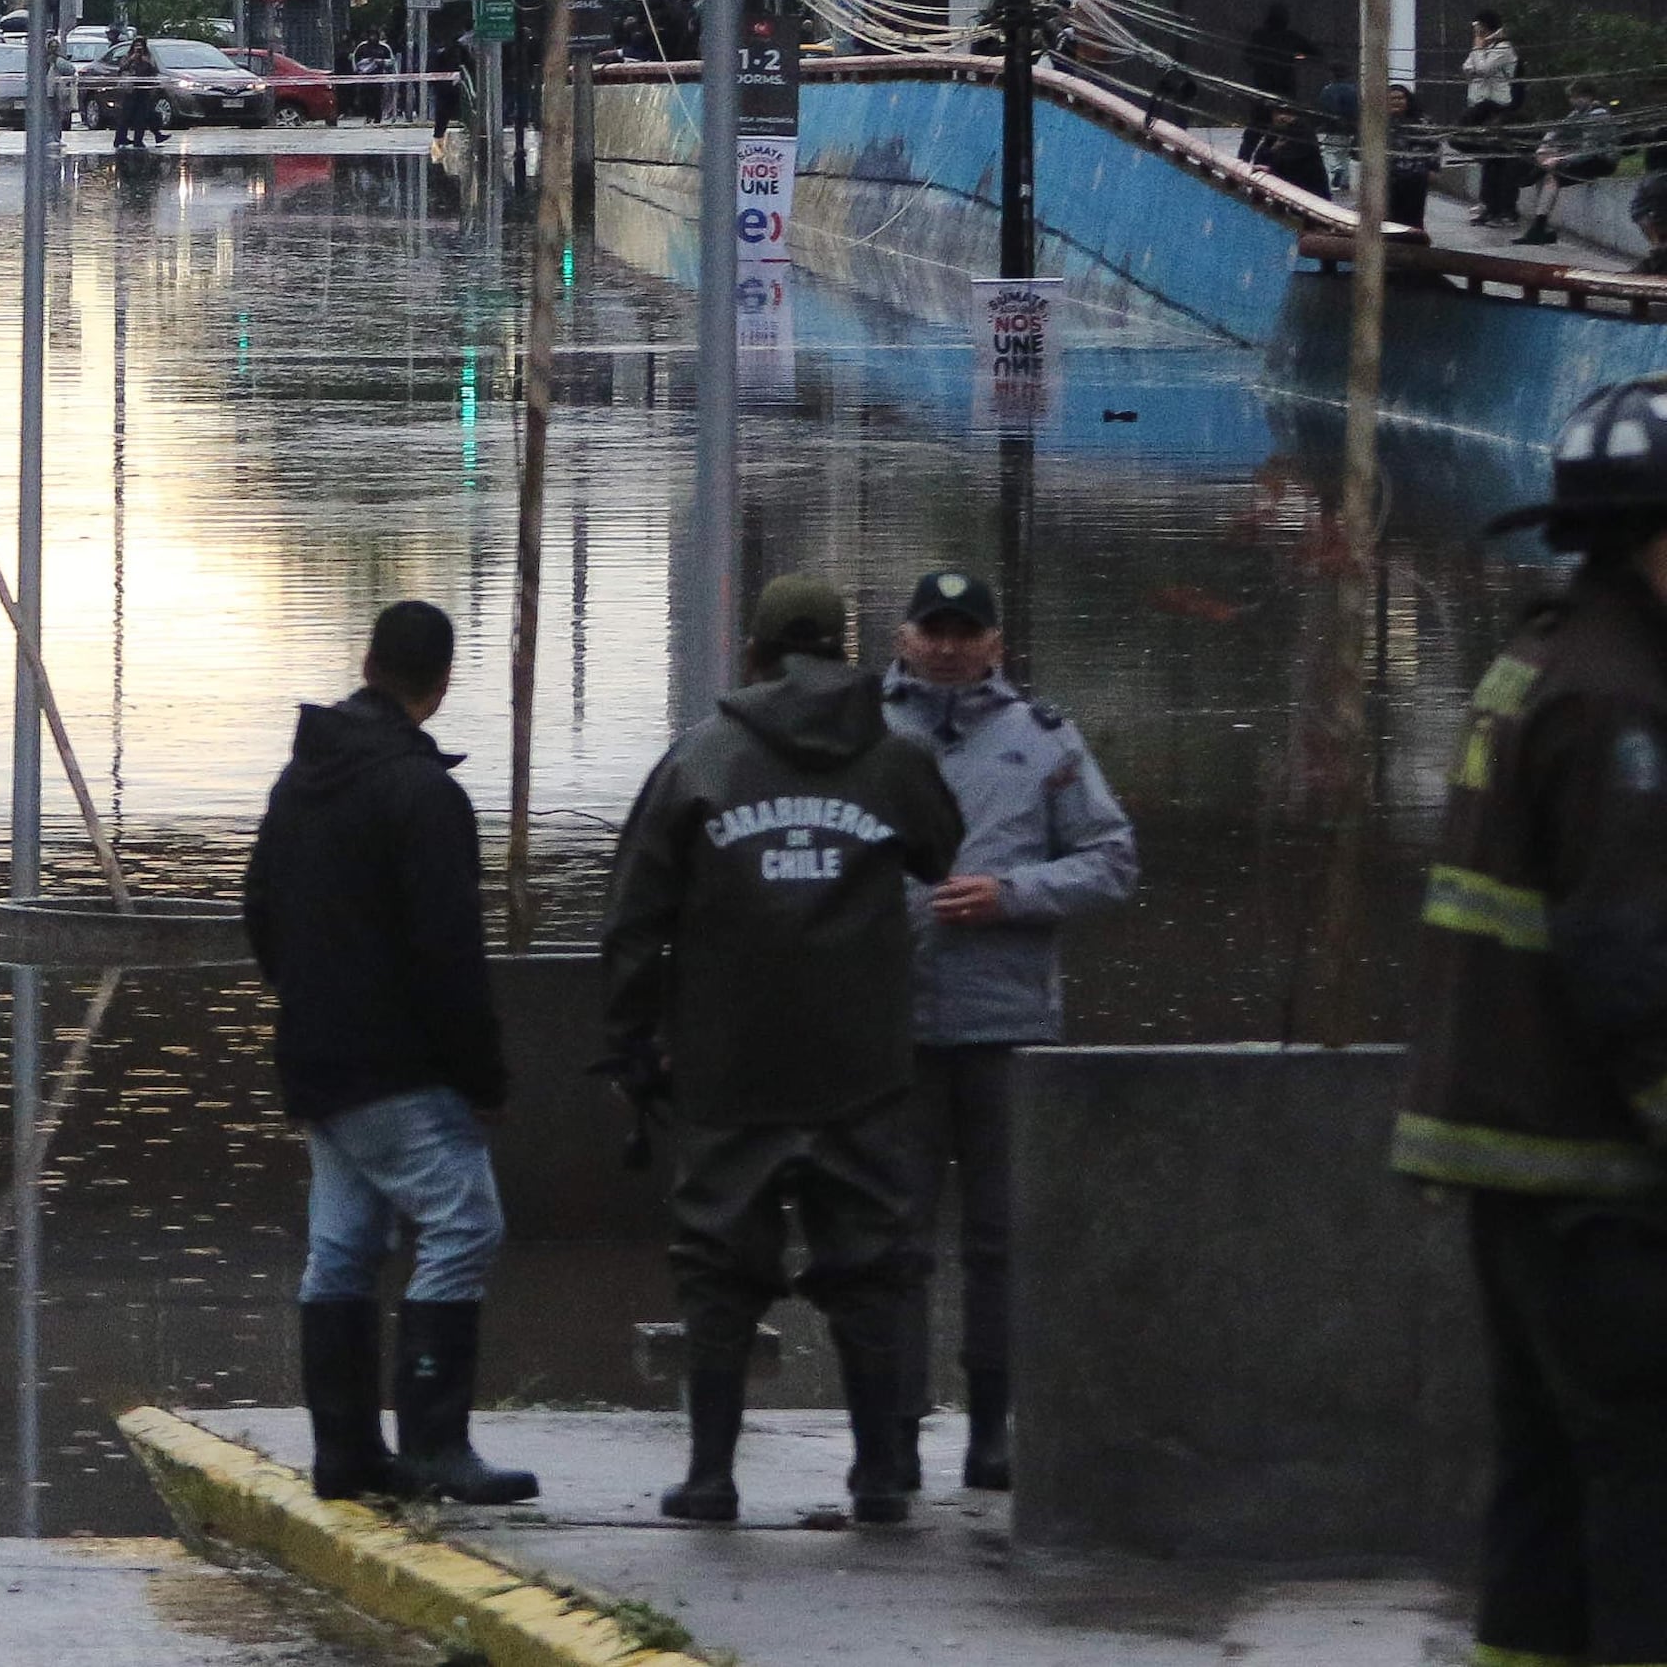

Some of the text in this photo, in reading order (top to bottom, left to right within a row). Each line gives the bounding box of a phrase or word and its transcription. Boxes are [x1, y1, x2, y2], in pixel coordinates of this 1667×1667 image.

[741, 164, 779, 179] NOS
[740, 180, 779, 195] UNE
[995, 315, 1042, 333] NOS
[994, 334, 1044, 354] UNE
[761, 847, 843, 880] CHILE
